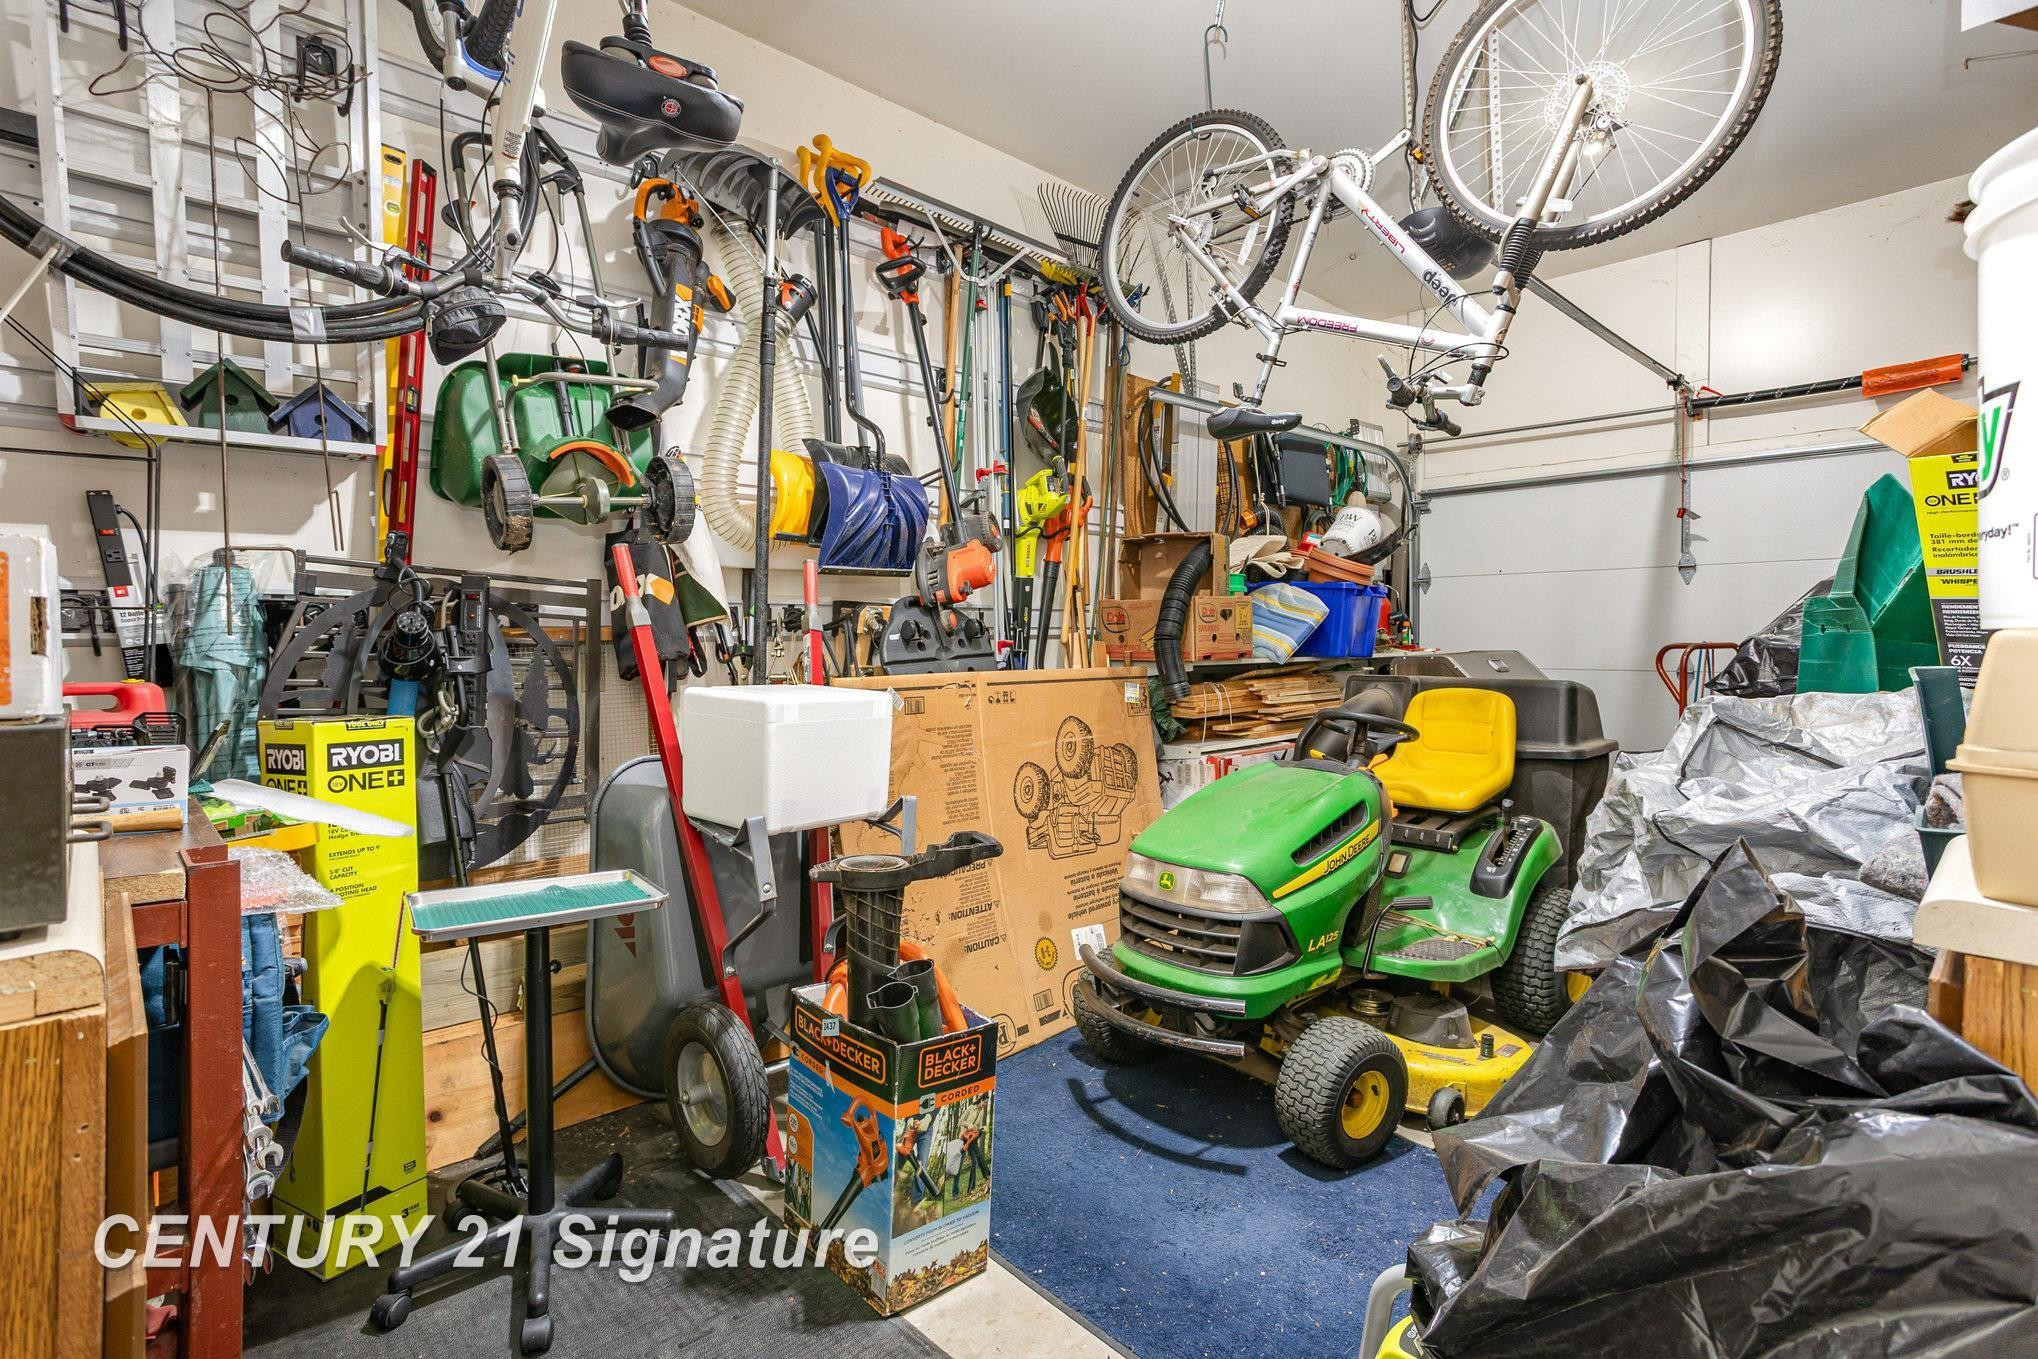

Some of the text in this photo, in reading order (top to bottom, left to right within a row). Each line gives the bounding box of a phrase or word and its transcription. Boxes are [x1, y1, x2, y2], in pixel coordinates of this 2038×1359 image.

[1361, 208, 1405, 254] LIBERTY
[1422, 269, 1457, 307] Jeep
[1297, 316, 1358, 333] FREEDOM
[1951, 655, 1972, 667] 6X
[266, 748, 306, 771] RYOBI
[330, 743, 401, 767] RYOBI
[328, 848, 356, 858] EXTENDS
[1325, 834, 1371, 873] JOHN DEERE
[335, 883, 364, 892] POSITION
[360, 885, 377, 893] HEAD
[949, 903, 993, 921] ATTENTION:
[965, 936, 1000, 954] CAUTION:
[925, 1044, 976, 1067] BLACK+
[924, 1056, 976, 1081] DECKER
[941, 1085, 980, 1103] CORDED
